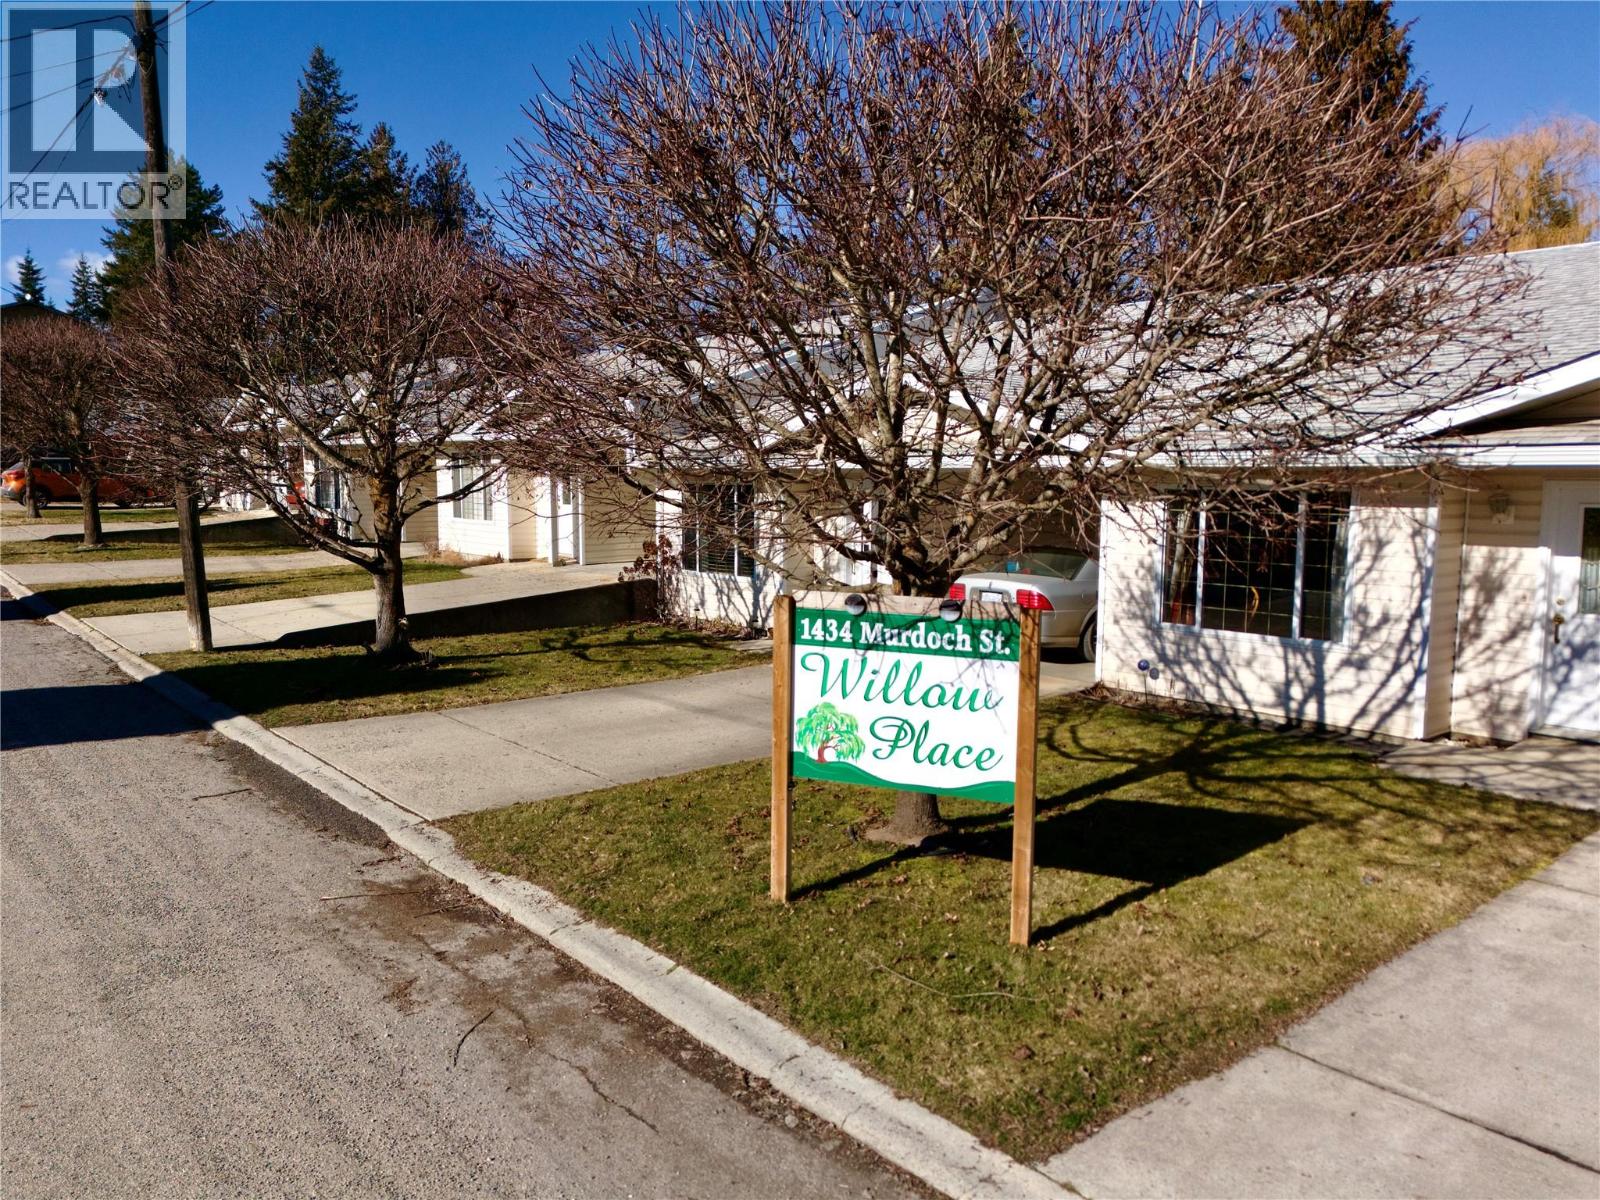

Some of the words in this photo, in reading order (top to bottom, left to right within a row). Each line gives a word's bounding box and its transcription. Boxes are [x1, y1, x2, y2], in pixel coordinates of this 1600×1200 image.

[800, 617, 853, 643] 1434
[859, 621, 973, 652] Murdoch
[979, 629, 1011, 655] St.
[800, 652, 1004, 713] Willow
[869, 715, 1004, 771] Place
